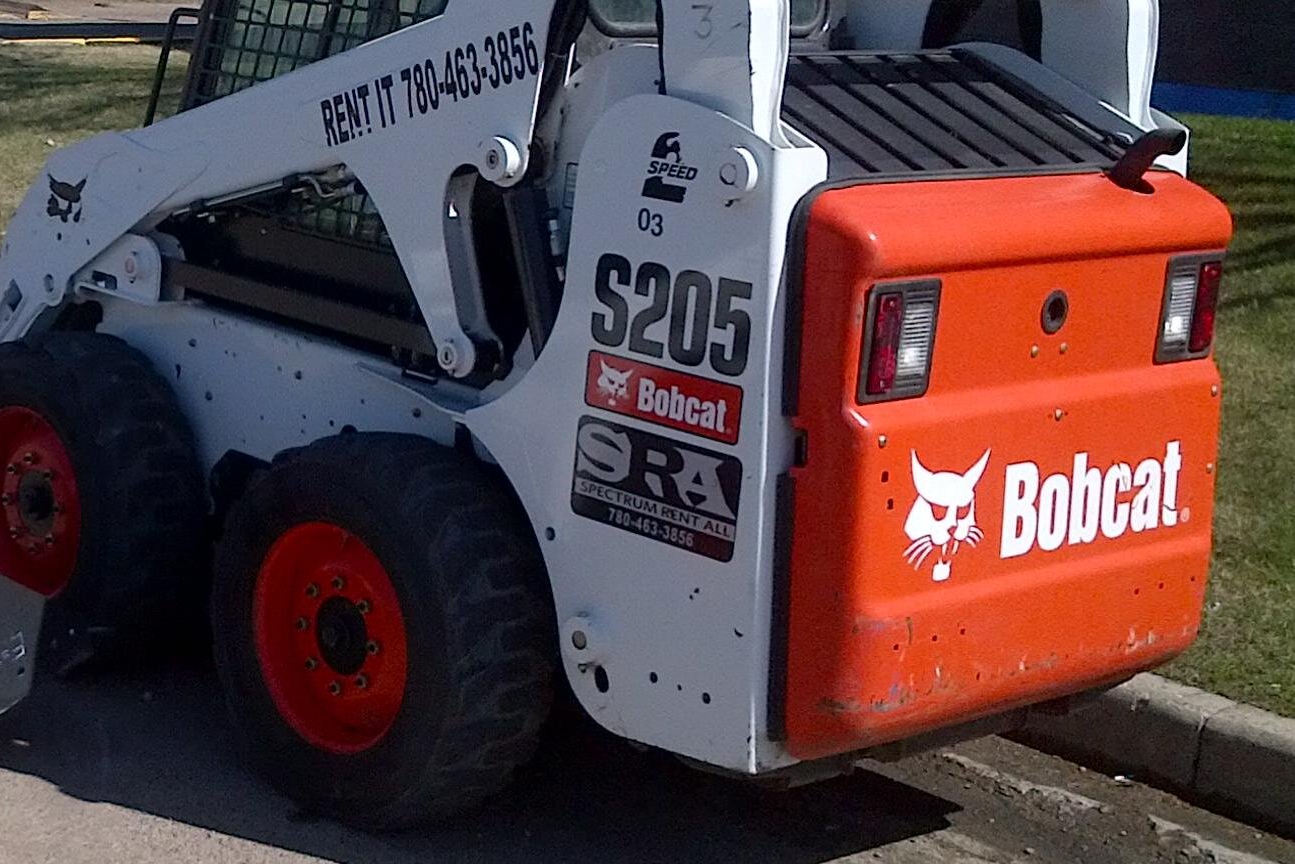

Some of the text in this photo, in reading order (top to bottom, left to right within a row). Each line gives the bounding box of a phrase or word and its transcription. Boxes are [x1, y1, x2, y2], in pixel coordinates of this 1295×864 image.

[320, 21, 539, 147] RENT IT 780-463-3856
[647, 160, 698, 181] SPEED
[637, 207, 664, 237] 03
[591, 252, 753, 377] S205
[637, 377, 727, 433] Bobcat
[575, 421, 737, 520] SRA
[580, 480, 731, 537] SPECTRUM RENT ALL
[608, 507, 695, 547] 780-463-3856
[1000, 440, 1181, 559] Bobcat
